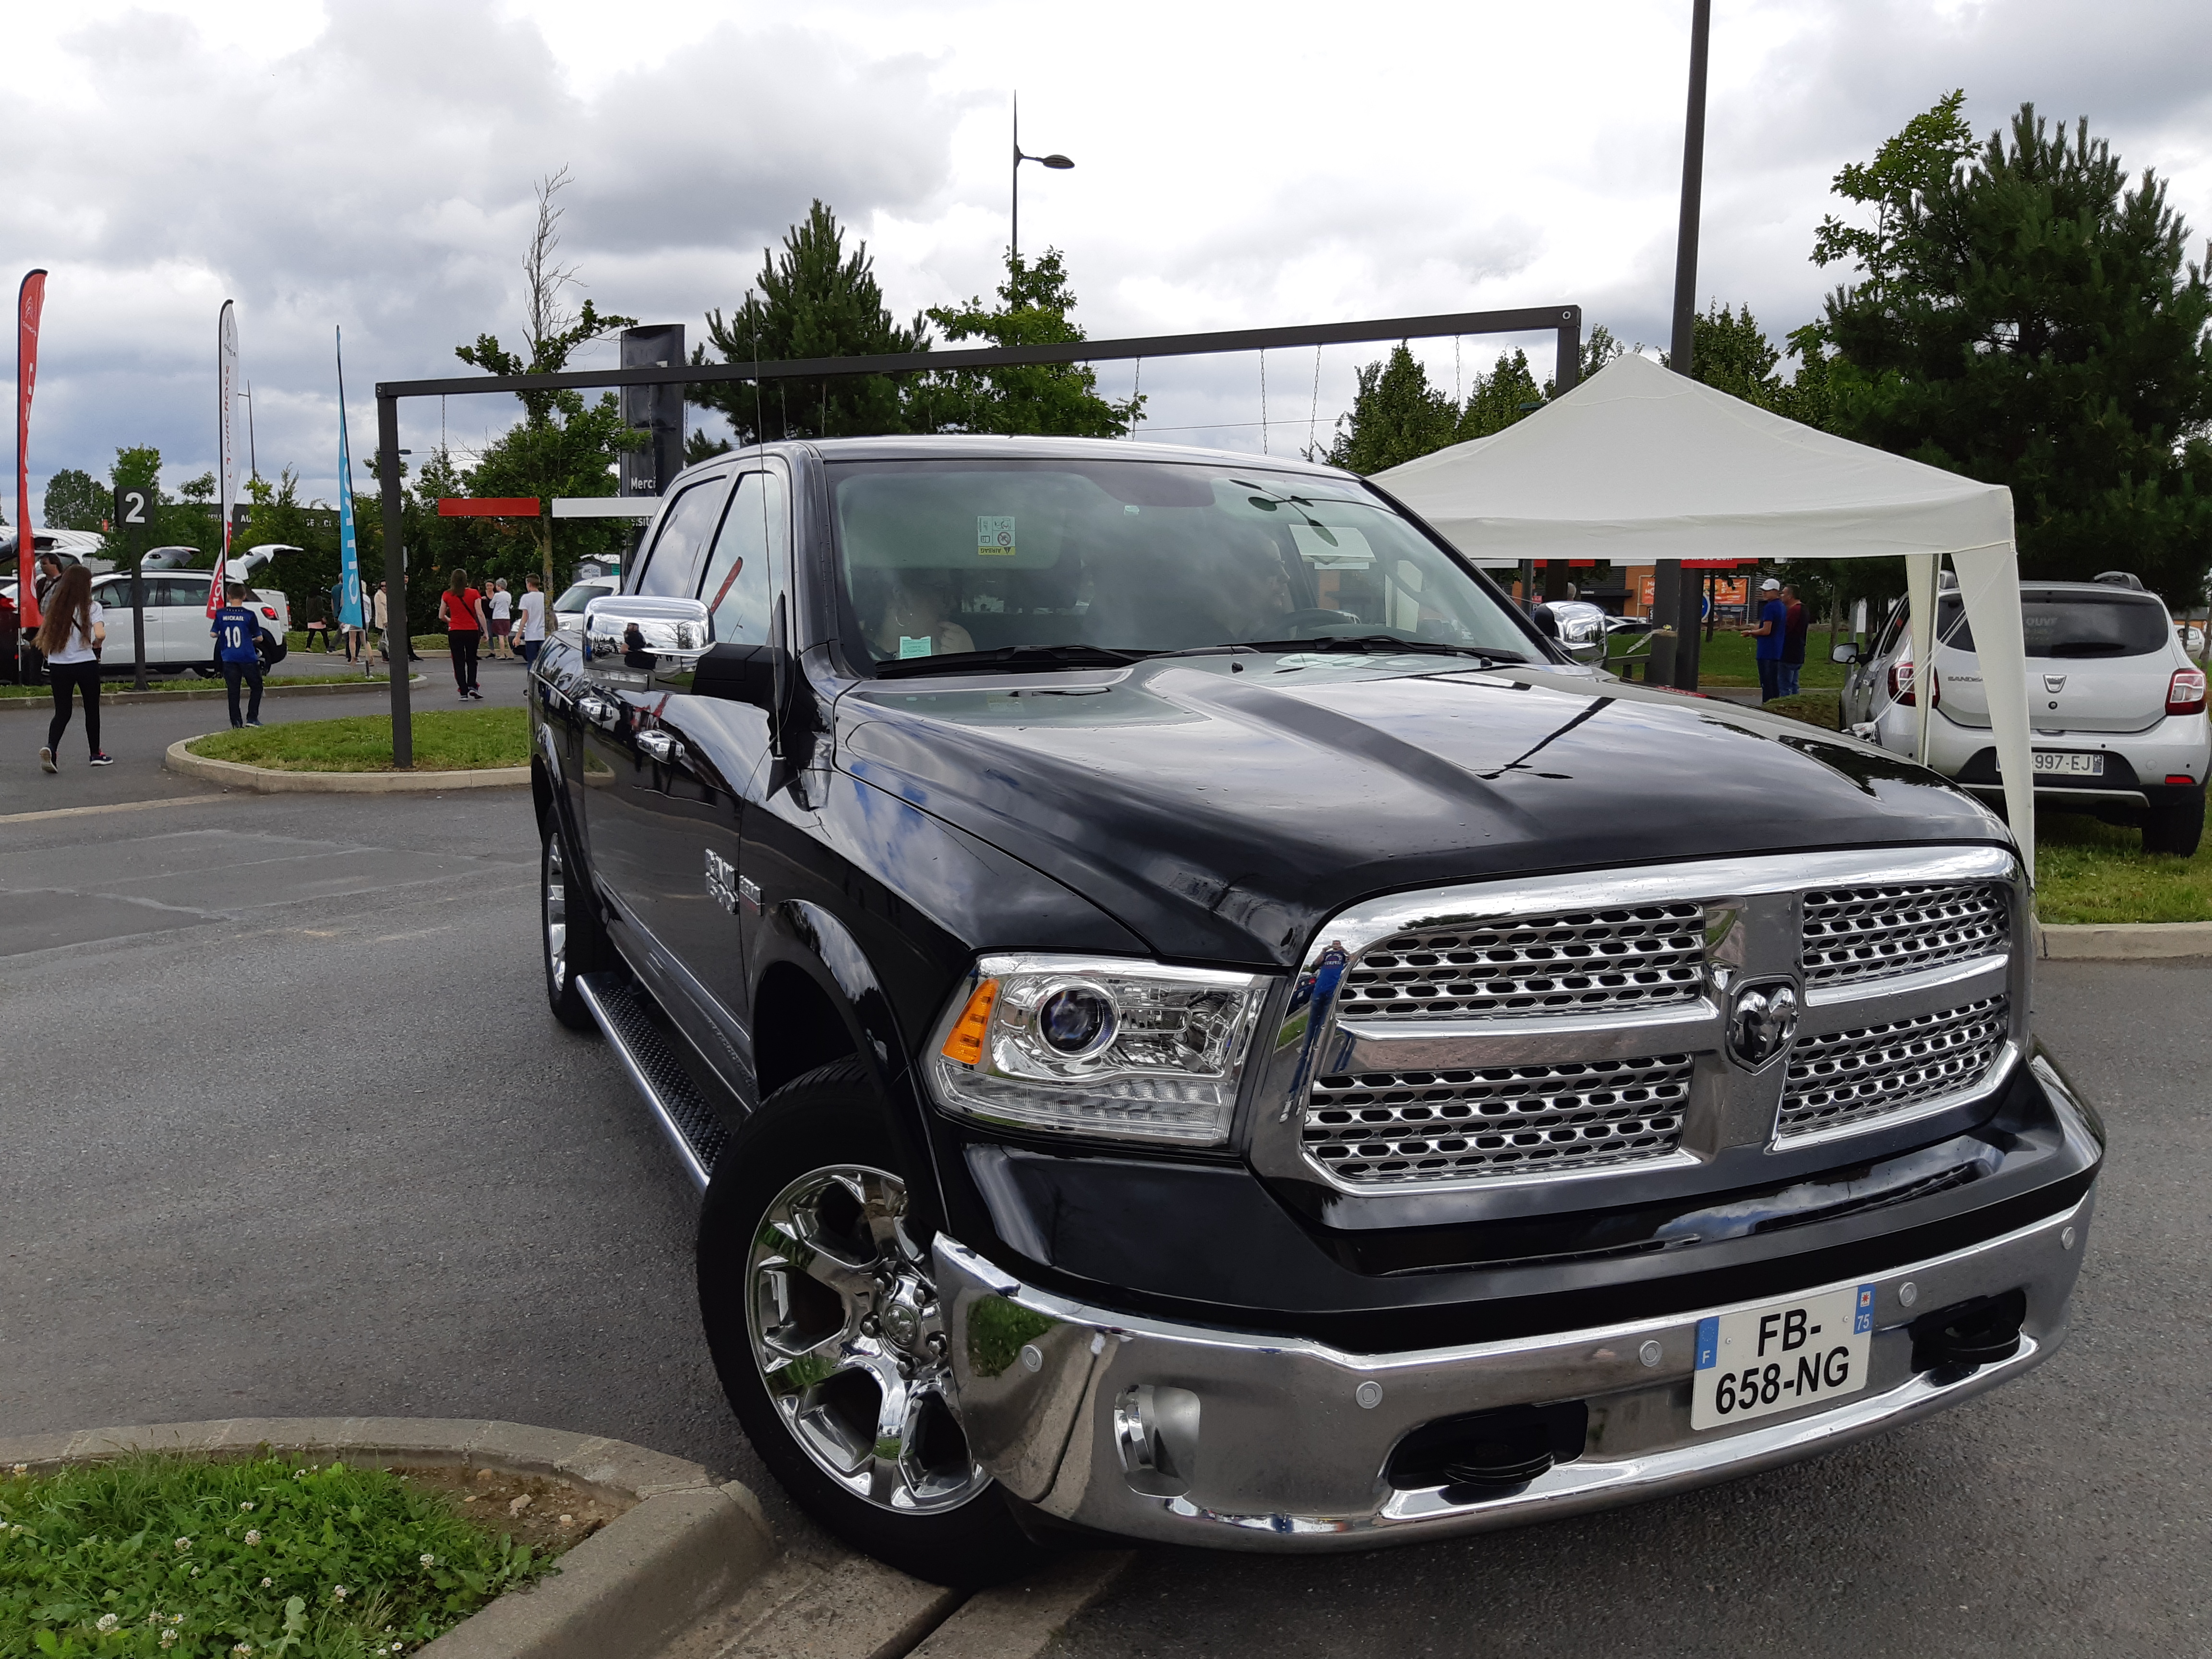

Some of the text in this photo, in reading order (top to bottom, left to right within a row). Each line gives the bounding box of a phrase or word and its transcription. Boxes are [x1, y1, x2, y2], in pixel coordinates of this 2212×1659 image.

[125, 492, 145, 523] 2
[225, 626, 241, 648] 10
[1757, 1309, 1822, 1357] FB-
[1857, 1313, 1870, 1331] 75
[1702, 1350, 1710, 1364] F
[1716, 1346, 1850, 1415] 658-NG
